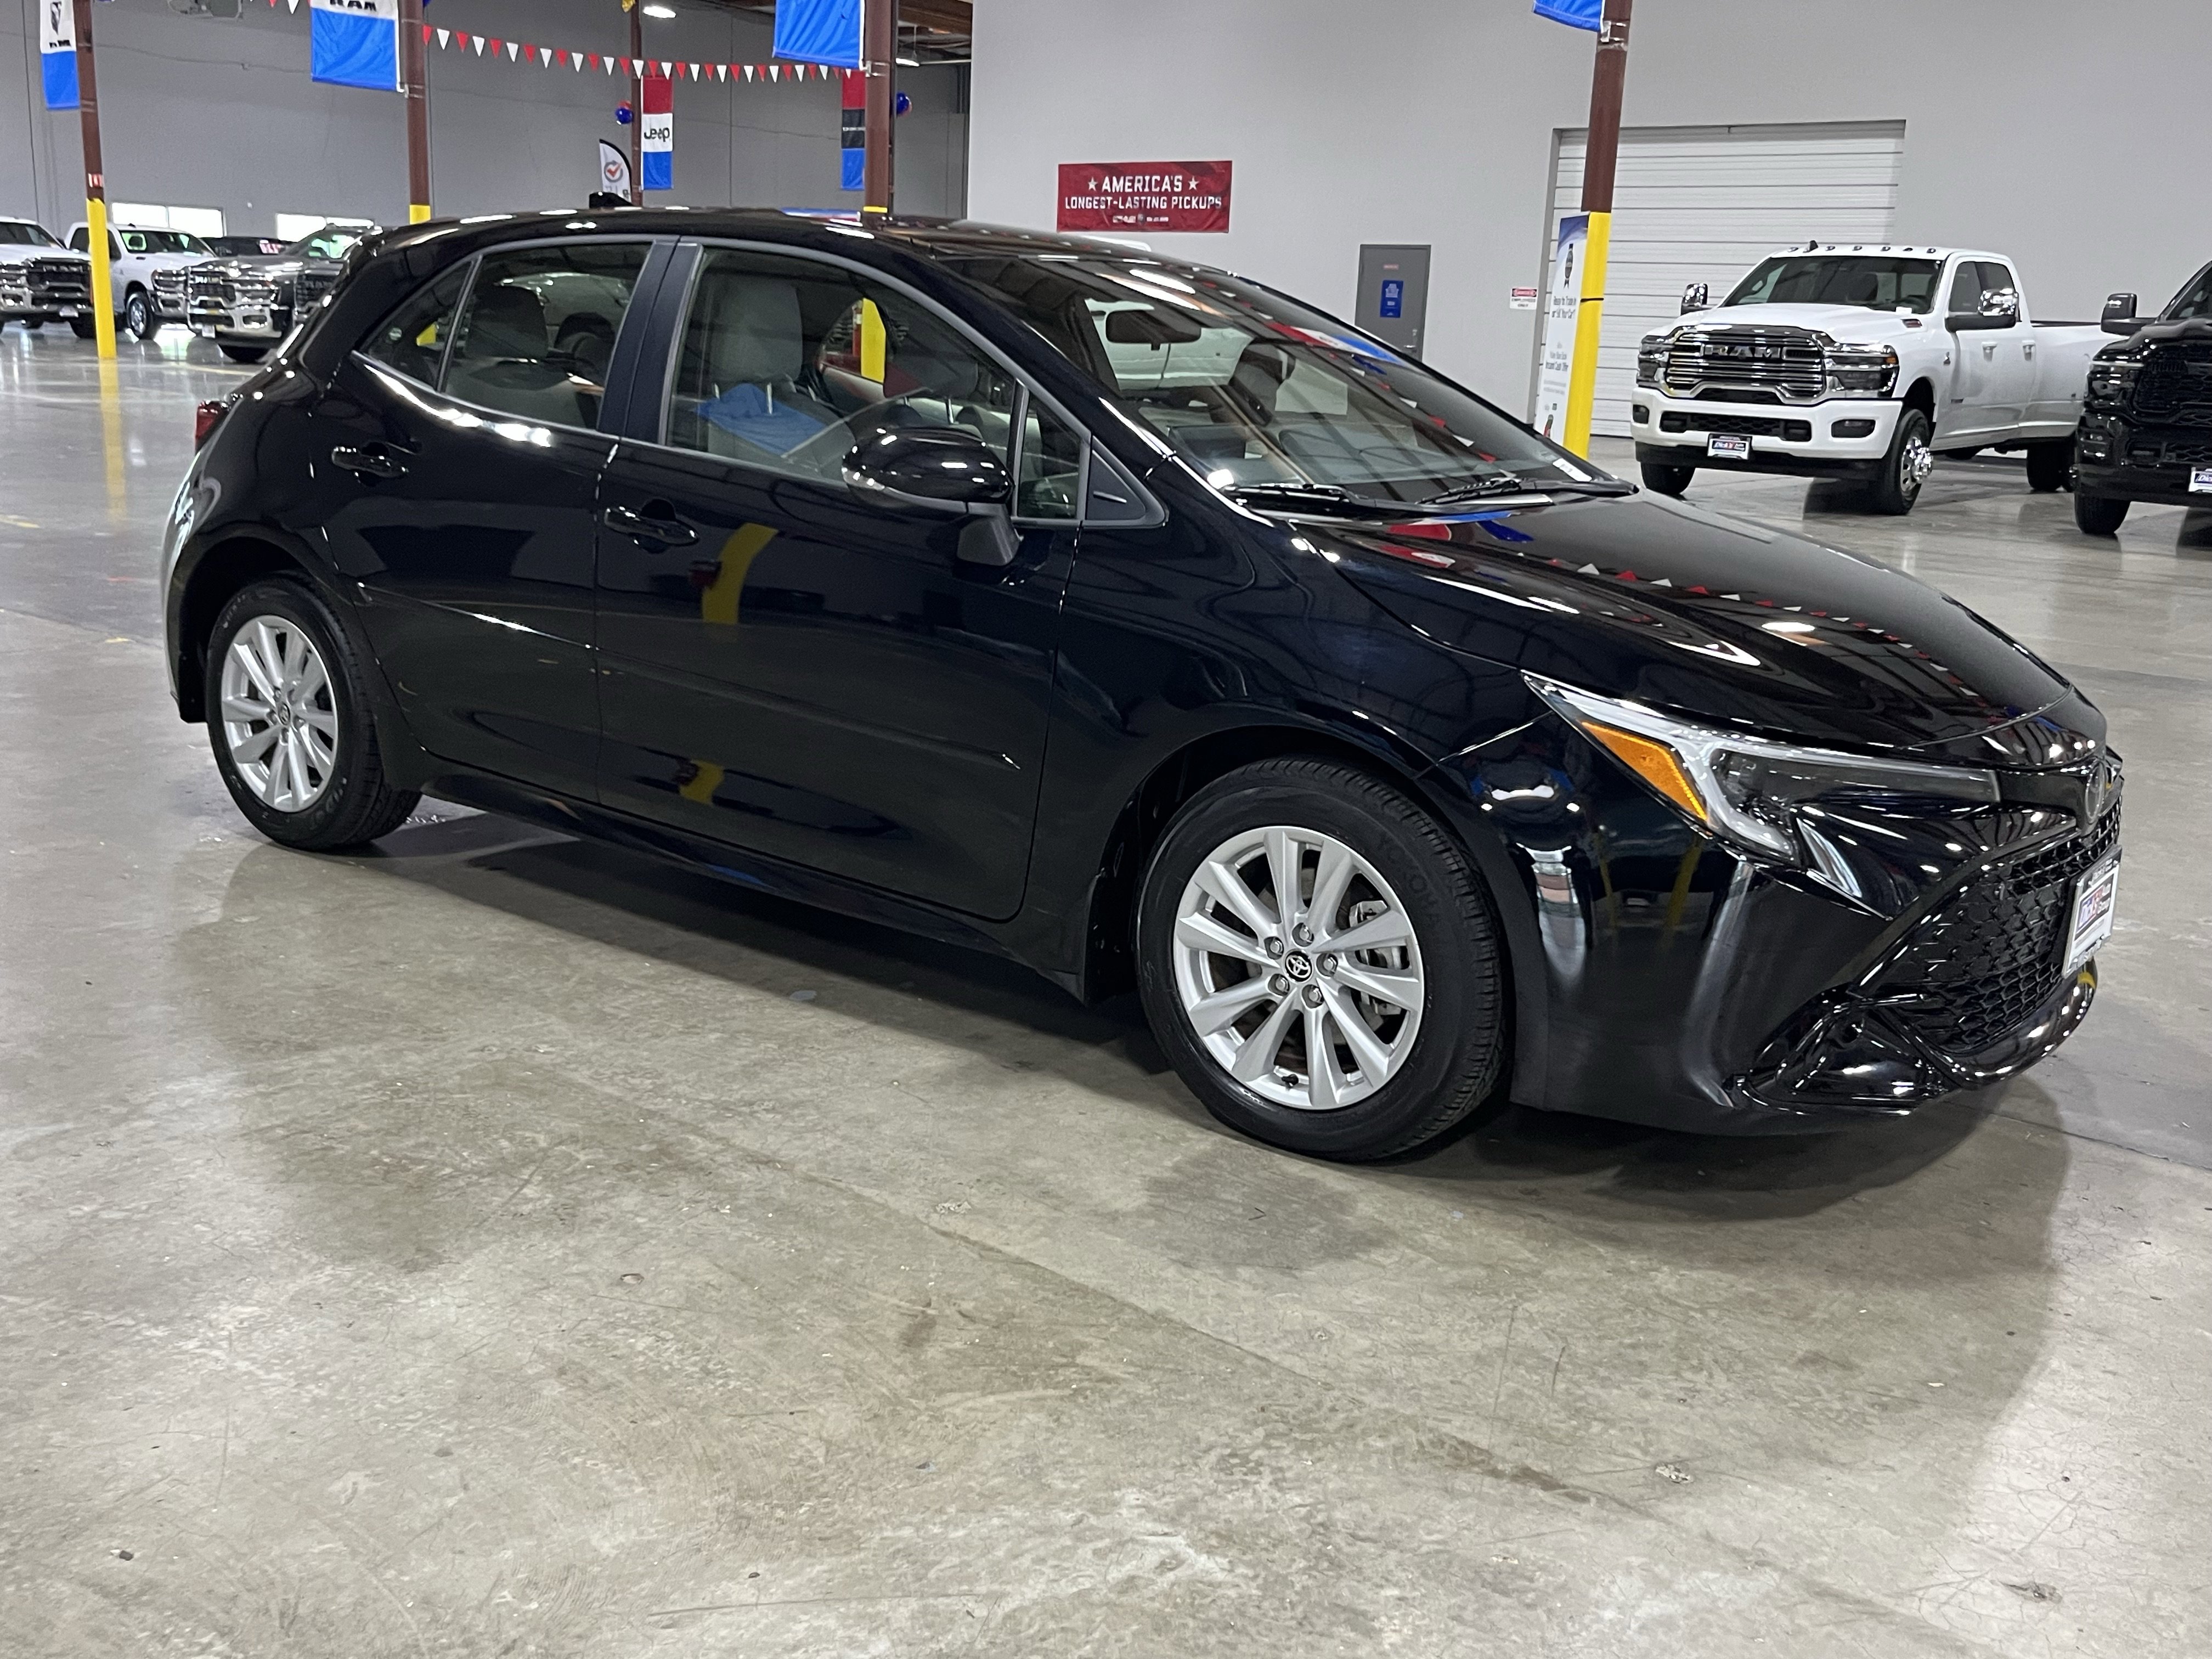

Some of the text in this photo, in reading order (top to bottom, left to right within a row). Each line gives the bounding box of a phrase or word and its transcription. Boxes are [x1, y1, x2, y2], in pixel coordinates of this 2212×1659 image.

[644, 127, 670, 142] Jeep
[1101, 175, 1183, 193] AMERICA'S
[1065, 196, 1222, 210] LONGEST-LASTING PICKUPS
[1704, 344, 1781, 358] RAM
